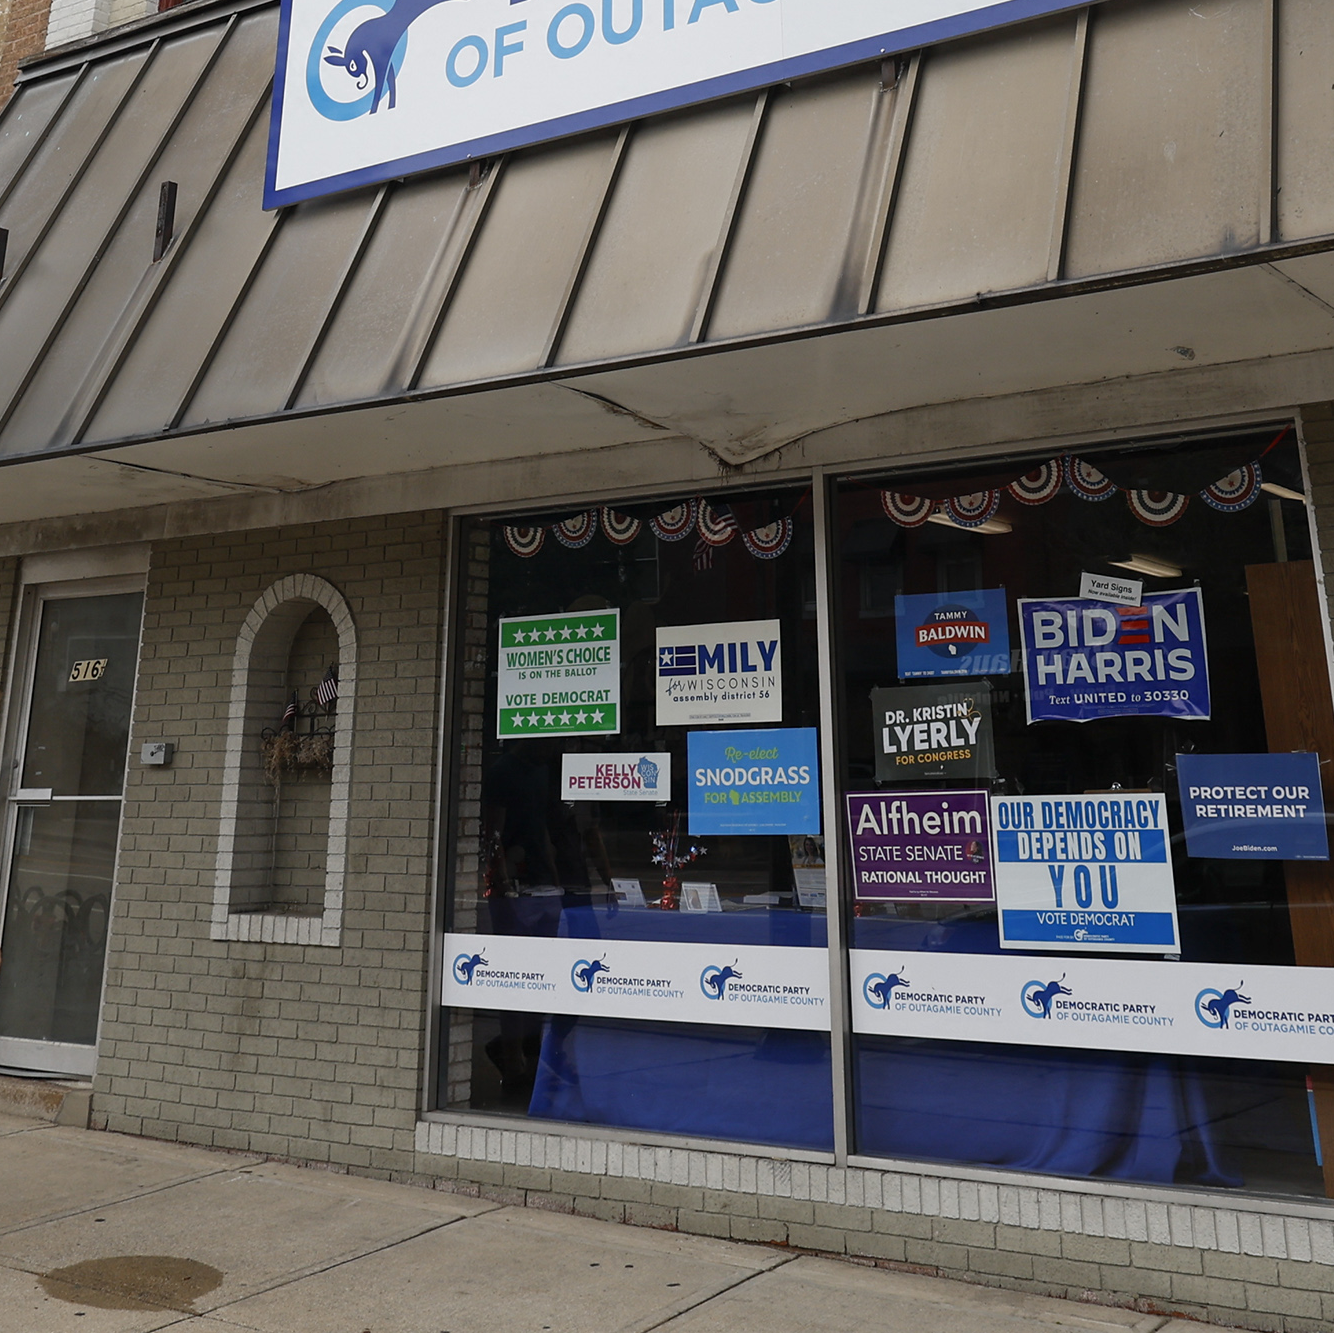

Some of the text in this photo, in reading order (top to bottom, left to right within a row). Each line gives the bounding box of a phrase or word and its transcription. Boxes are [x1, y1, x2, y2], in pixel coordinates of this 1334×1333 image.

[444, 19, 527, 89] OF
[1091, 579, 1133, 594] Yard Signs
[934, 611, 967, 620] TAMMY
[1032, 603, 1190, 649] BIDEN
[919, 625, 986, 642] BALDWIN
[506, 646, 611, 668] WOMEN'S CHOICE
[659, 640, 778, 677] EMILY
[518, 667, 597, 680] IS ON THE BALLOT
[1036, 648, 1195, 686] HARRIS
[665, 676, 775, 696] for WISCONSIN
[506, 689, 611, 706] VOTE DEMOCRAT
[673, 690, 770, 703] assembly district 56
[1049, 690, 1189, 705] Text UNITED to 30330
[885, 702, 967, 725] DR. KRISTIN
[882, 717, 982, 754] LYERLY
[725, 746, 779, 763] Re-elect
[895, 749, 971, 765] FOR CONGRESS
[596, 764, 637, 777] KELLY
[695, 766, 810, 786] SNODGRASS
[569, 776, 641, 789] PETERSON
[704, 791, 802, 803] FOR ASSEMBLY
[1189, 786, 1310, 799] PROTECT OUR
[856, 801, 982, 835] Alfheim
[998, 800, 1160, 829] OUR DEMOCRACY
[1195, 804, 1307, 818] RETIREMENT
[1017, 831, 1142, 860] DEPENDS ON
[859, 846, 902, 861] STATE
[905, 845, 964, 861] SENATE
[861, 871, 986, 884] RATIONAL THOUGHT
[1048, 864, 1119, 909] YOU
[1036, 912, 1135, 926] VOTE DEMOCRAT
[476, 970, 545, 981] DEMOCRATIC PARTY
[596, 976, 672, 988] DEMOCRATIC PARTY
[476, 979, 556, 991] OF OUTAGAMIE COUNTY
[728, 983, 810, 995] DEMOCRATIC PARTY
[608, 988, 651, 996] OUTAGAMIE
[652, 989, 684, 999] COUNTY
[728, 994, 824, 1006] OF OUTAGAMIE COUNTY
[894, 991, 986, 1005] DEMOCRATIC PARTY
[894, 1003, 1002, 1017] OF OUTAGAMIE COUNTY
[1056, 1000, 1156, 1014] DEMOCRATIC PARTY
[1056, 1012, 1174, 1026] OF OUTAGAMIE COUNTY
[1233, 1009, 1305, 1021] DEMOCRATIC
[1234, 1022, 1249, 1031] OF
[1252, 1023, 1316, 1034] OUTAGAMIE
